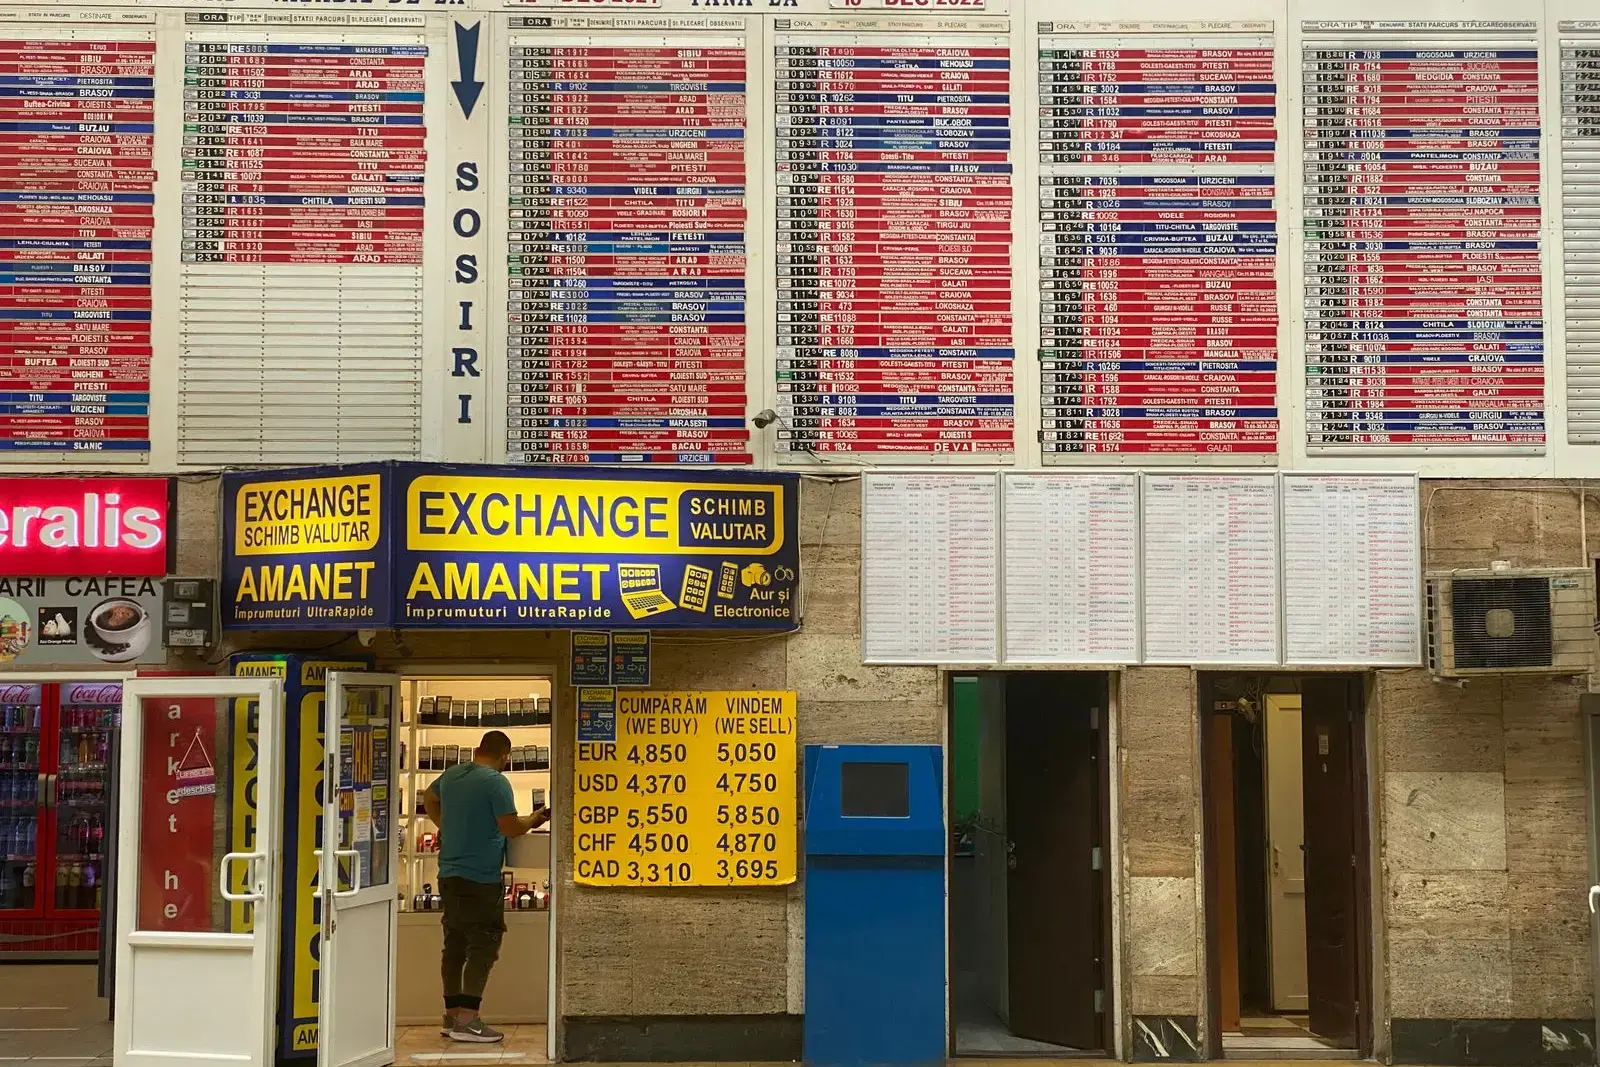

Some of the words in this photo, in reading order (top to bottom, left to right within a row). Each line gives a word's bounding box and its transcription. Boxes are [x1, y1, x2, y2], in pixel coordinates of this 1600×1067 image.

[836, 152, 853, 160] 1784
[351, 174, 382, 182] GALATI
[1100, 177, 1117, 185] 7036
[836, 221, 854, 229] 9016
[1097, 234, 1115, 243] 5016
[453, 162, 481, 424] SOSIRI
[1365, 321, 1384, 329] 8124
[244, 483, 371, 522] EXCHANGE
[690, 497, 765, 516] SCHIMB
[0, 492, 162, 549] ralis
[419, 491, 668, 538] EXCHANGE
[244, 523, 299, 547] SCHIMB
[304, 521, 369, 544] VALUTAR
[691, 523, 766, 541] VALUTAR
[65, 576, 156, 597] CAFEA
[236, 561, 375, 602] AMANET
[406, 562, 610, 600] AMANET
[750, 588, 774, 600] Aur
[778, 588, 790, 603] și
[234, 606, 300, 620] Împrumuturi
[308, 604, 373, 618] UltraRapide
[406, 604, 507, 620] Împrumuturi
[518, 606, 610, 620] UltraRapide
[714, 605, 790, 618] Electronice
[240, 667, 283, 676] AMANET
[620, 694, 707, 714] CUMPĂRĂM
[726, 698, 782, 714] VINDEM
[627, 718, 656, 735] (WE
[660, 718, 698, 735] BUY)
[715, 718, 745, 735] (WE
[749, 718, 792, 735] SELL)
[579, 743, 616, 761] EUR
[627, 744, 686, 766] 4,850
[718, 743, 776, 765] 5,050
[579, 774, 618, 792] USD
[627, 774, 686, 797] 4,370
[716, 773, 776, 796] 4,750
[579, 806, 618, 824] GBP
[627, 804, 687, 829] 5,550
[717, 805, 779, 828] 5,850
[579, 834, 616, 851] CHF
[629, 834, 688, 856] 4,500
[716, 833, 776, 856] 4,870
[579, 860, 619, 877] CAD
[627, 862, 690, 883] 3,310
[717, 860, 778, 882] 3,695
